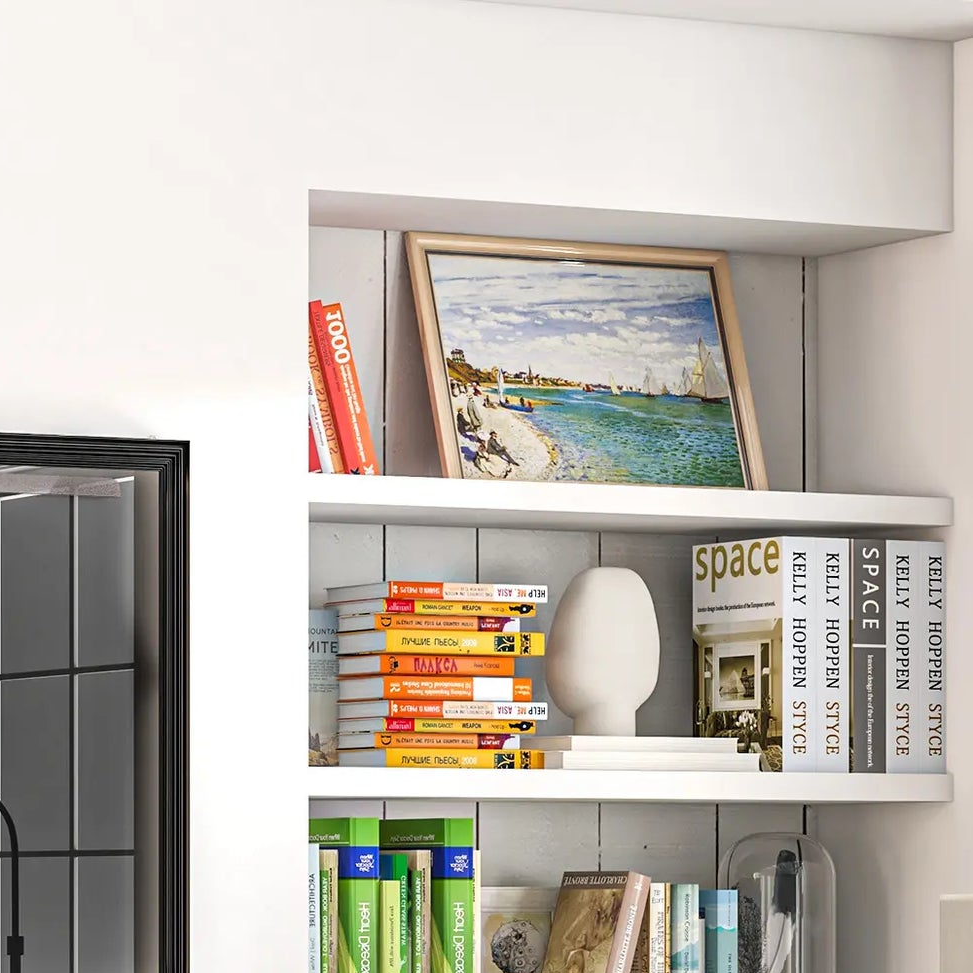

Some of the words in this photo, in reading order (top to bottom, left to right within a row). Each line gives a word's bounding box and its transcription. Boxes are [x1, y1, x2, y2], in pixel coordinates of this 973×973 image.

[497, 587, 513, 598] ASIA
[528, 588, 546, 598] HELP
[696, 540, 780, 593] space
[792, 552, 807, 606] KELLY
[826, 552, 840, 607] KELLY
[862, 547, 879, 629] SPACE
[896, 555, 910, 609] KELLY
[928, 556, 942, 610] KELLY
[401, 637, 431, 647] ЛУЧШИЕ
[792, 618, 807, 689] HOPPEN
[826, 619, 840, 689] HOPPEN
[896, 621, 910, 691] HOPPEN
[928, 622, 942, 692] HOPPEN
[497, 705, 513, 715] ASIA
[528, 705, 546, 716] HELP
[401, 756, 431, 765] ЛУЧШИЕ
[588, 876, 627, 885] CHARLOTTE
